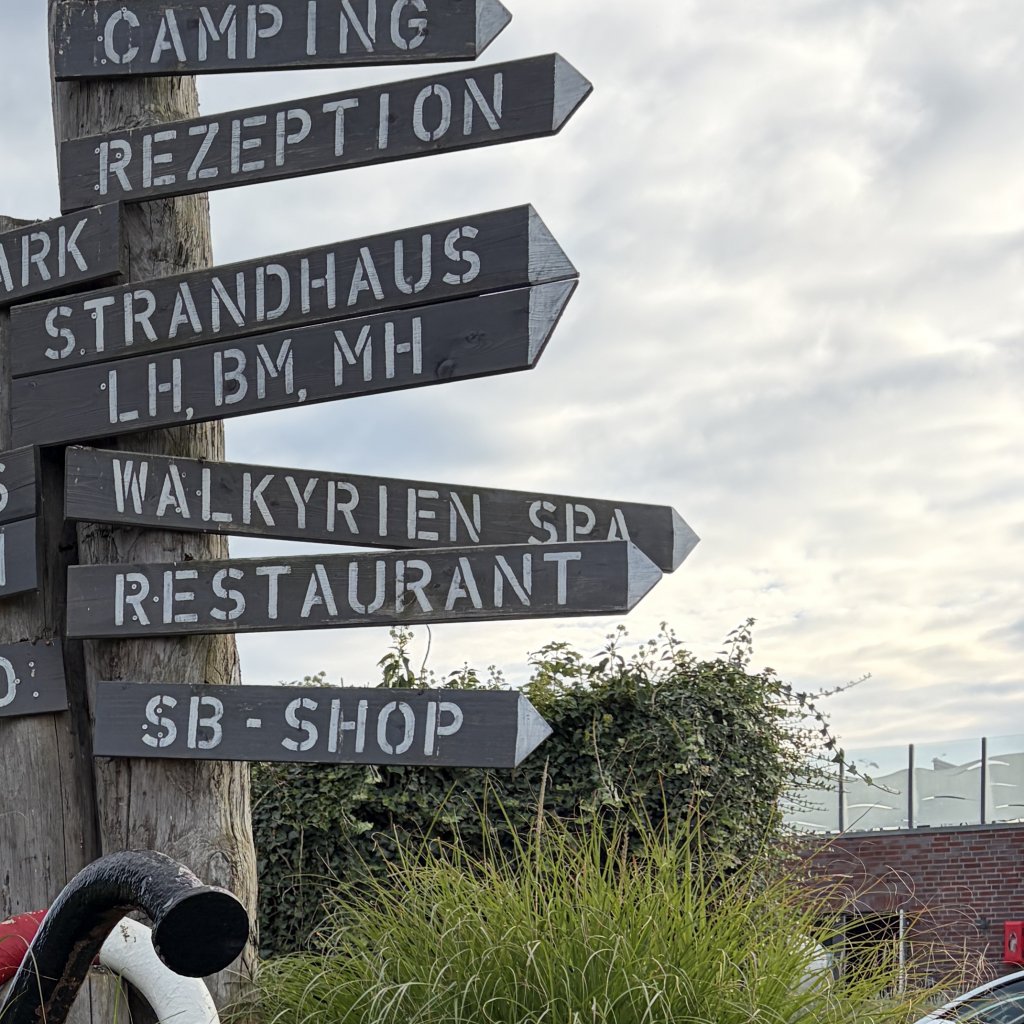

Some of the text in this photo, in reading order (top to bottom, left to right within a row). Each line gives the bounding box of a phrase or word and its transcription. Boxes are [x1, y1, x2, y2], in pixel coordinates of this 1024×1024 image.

[103, 0, 428, 64] CAMPING
[99, 73, 504, 195] REZEPTION
[44, 225, 481, 361] STRANDHAUS
[108, 317, 422, 423] LH, BM, MH
[112, 458, 630, 545] WALKYRIEN SPA
[114, 551, 582, 627] RESTAURANT
[281, 697, 464, 757] SHOP
